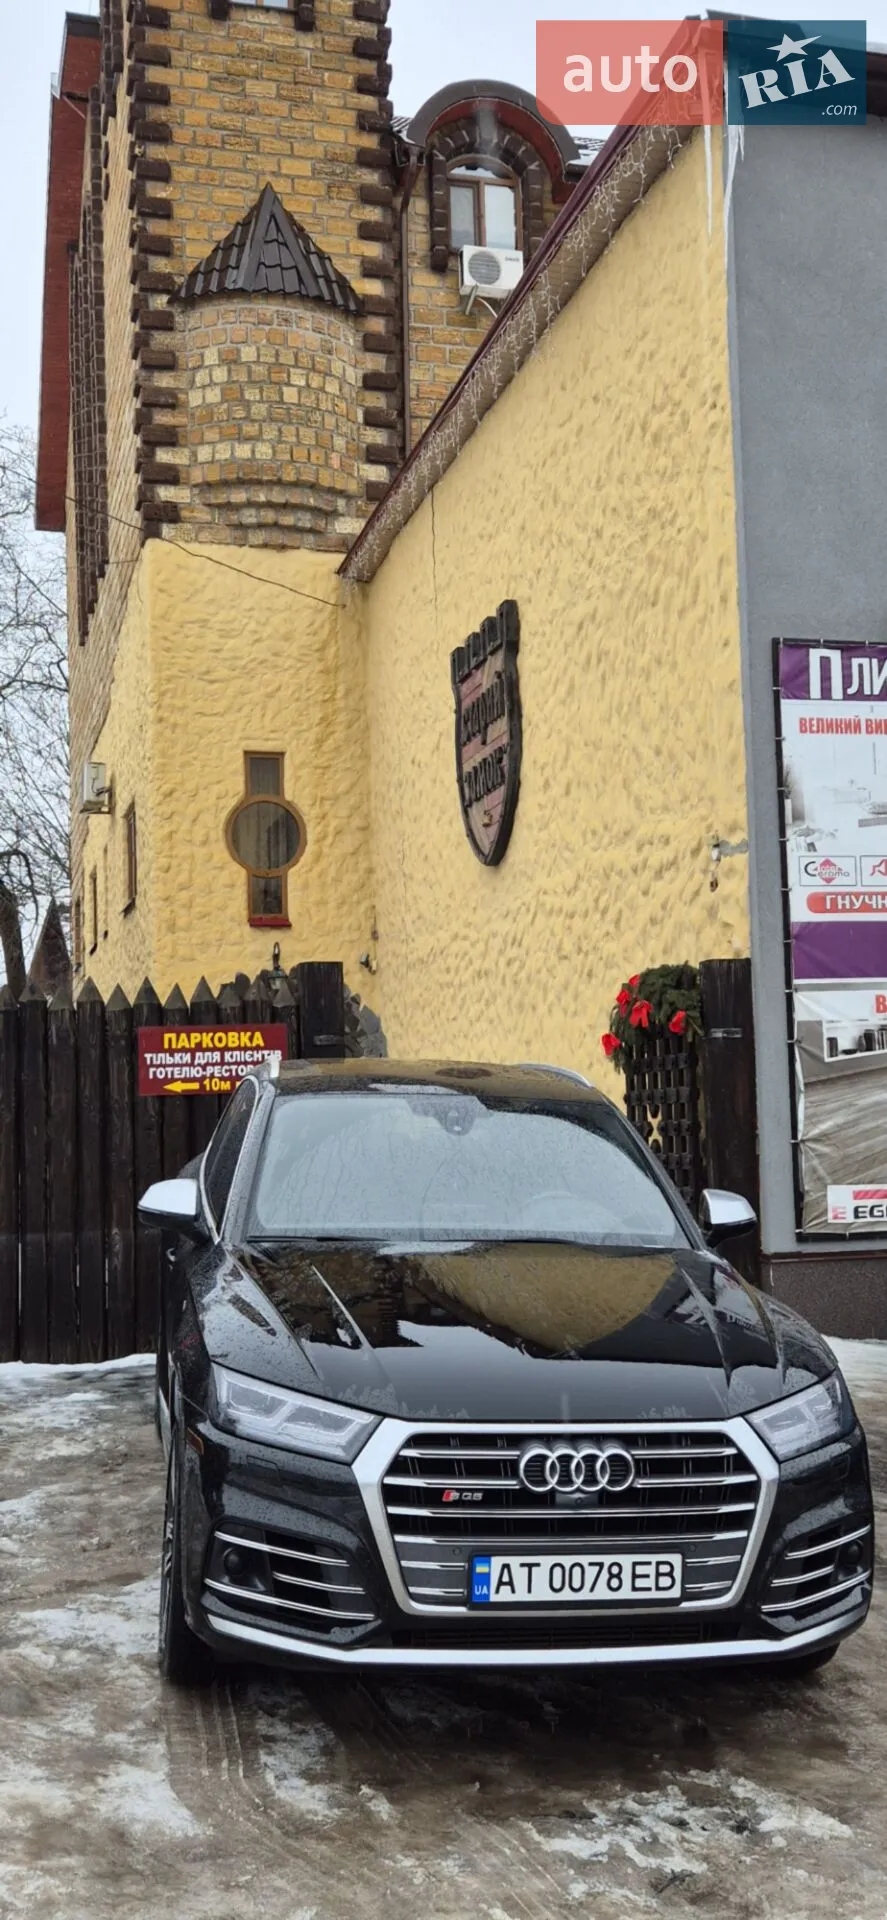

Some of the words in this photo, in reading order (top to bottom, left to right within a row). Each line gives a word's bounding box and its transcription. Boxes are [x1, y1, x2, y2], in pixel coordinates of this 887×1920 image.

[799, 715, 862, 735] ВЕЛИКИЙ
[163, 1031, 265, 1049] ПАРКОВКА
[144, 1052, 191, 1065] ТІЛЬКИ
[194, 1051, 221, 1065] ДЛЯ
[853, 1204, 887, 1220] EG
[494, 1561, 541, 1595] AT
[549, 1560, 624, 1594] 0078
[631, 1560, 676, 1592] EB
[474, 1584, 489, 1596] UA
